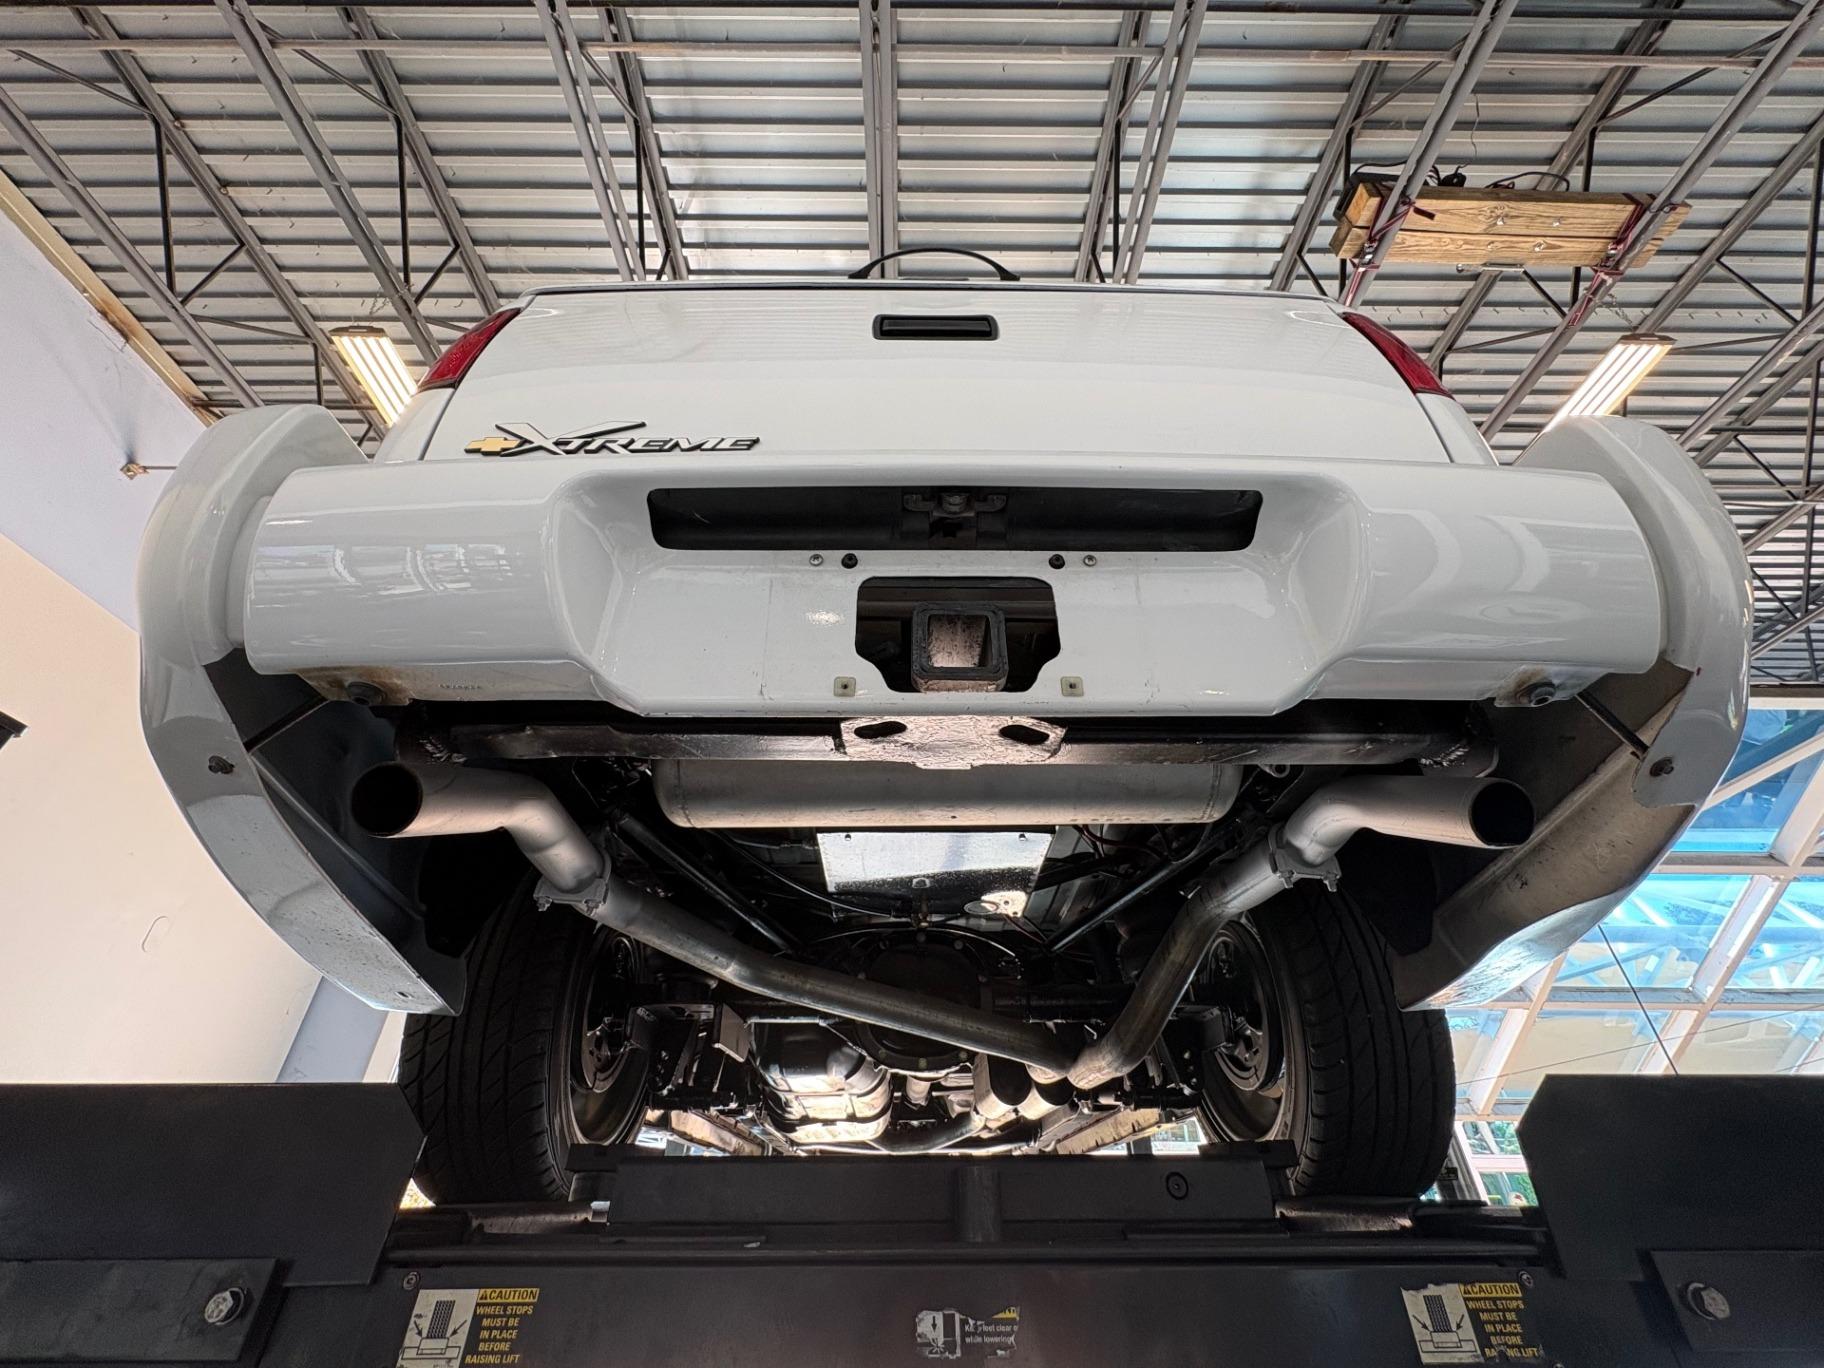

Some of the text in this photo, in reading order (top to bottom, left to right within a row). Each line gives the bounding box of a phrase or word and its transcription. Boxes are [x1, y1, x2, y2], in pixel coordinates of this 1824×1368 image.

[495, 421, 760, 457] XTREME
[1471, 1285, 1519, 1295] CAUTION
[489, 1290, 537, 1300] CAUTION
[1467, 1300, 1524, 1309] WHEEL STOPS
[476, 1306, 533, 1315] WHEEL STOPS
[1479, 1312, 1518, 1321] MUST BE
[482, 1318, 520, 1326] MUST BE
[1484, 1324, 1523, 1333] IN PLACE
[480, 1330, 518, 1339] IN PLACE
[1490, 1336, 1523, 1345] BEFORE
[478, 1342, 511, 1351] BEFORE
[1484, 1348, 1538, 1358] RANG LIFT
[465, 1355, 520, 1364] RAISING LIFT
